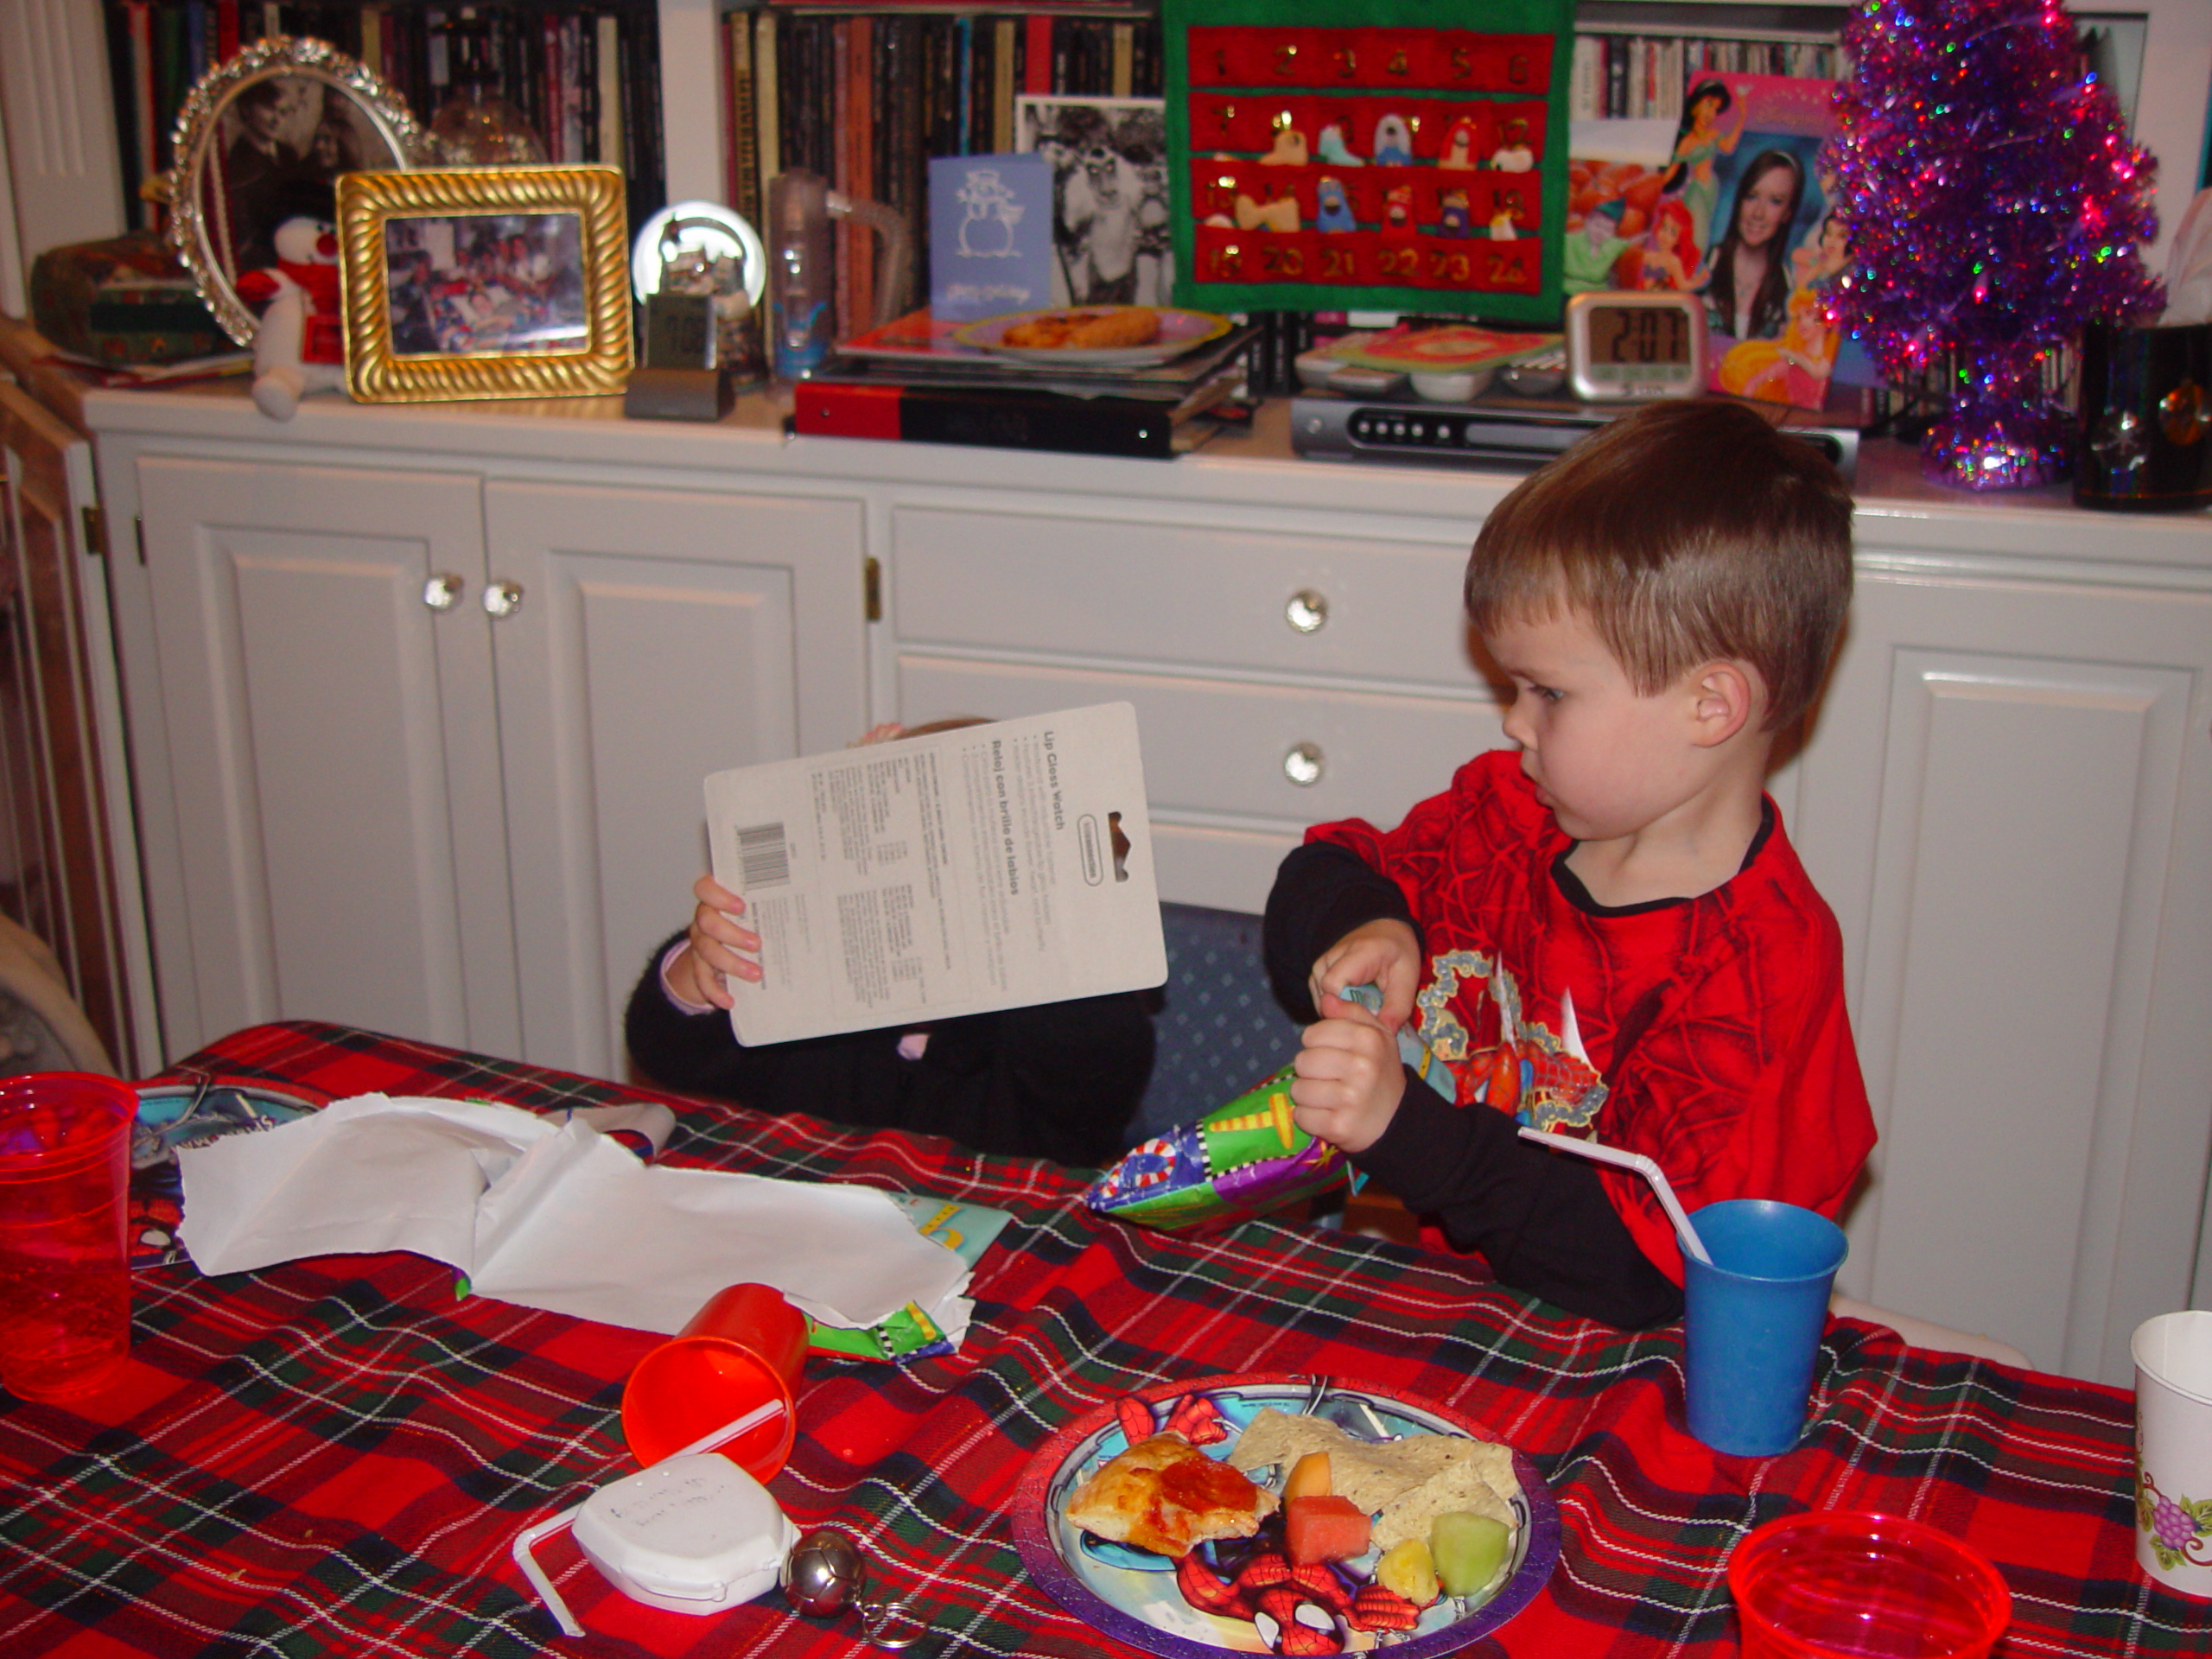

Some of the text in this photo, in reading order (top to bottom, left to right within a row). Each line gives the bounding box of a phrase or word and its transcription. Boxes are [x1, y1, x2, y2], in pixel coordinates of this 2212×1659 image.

[1216, 45, 1529, 84] 1 2 3 4 5 6
[1262, 246, 1303, 275] 20
[1322, 248, 1355, 276] 21
[1379, 248, 1419, 276] 22
[1430, 250, 1469, 282] 23
[1611, 310, 1678, 362] 2:07
[1044, 731, 1065, 830] Lip Gloss Watch
[991, 741, 1019, 895] Reloj con brillo de labios
